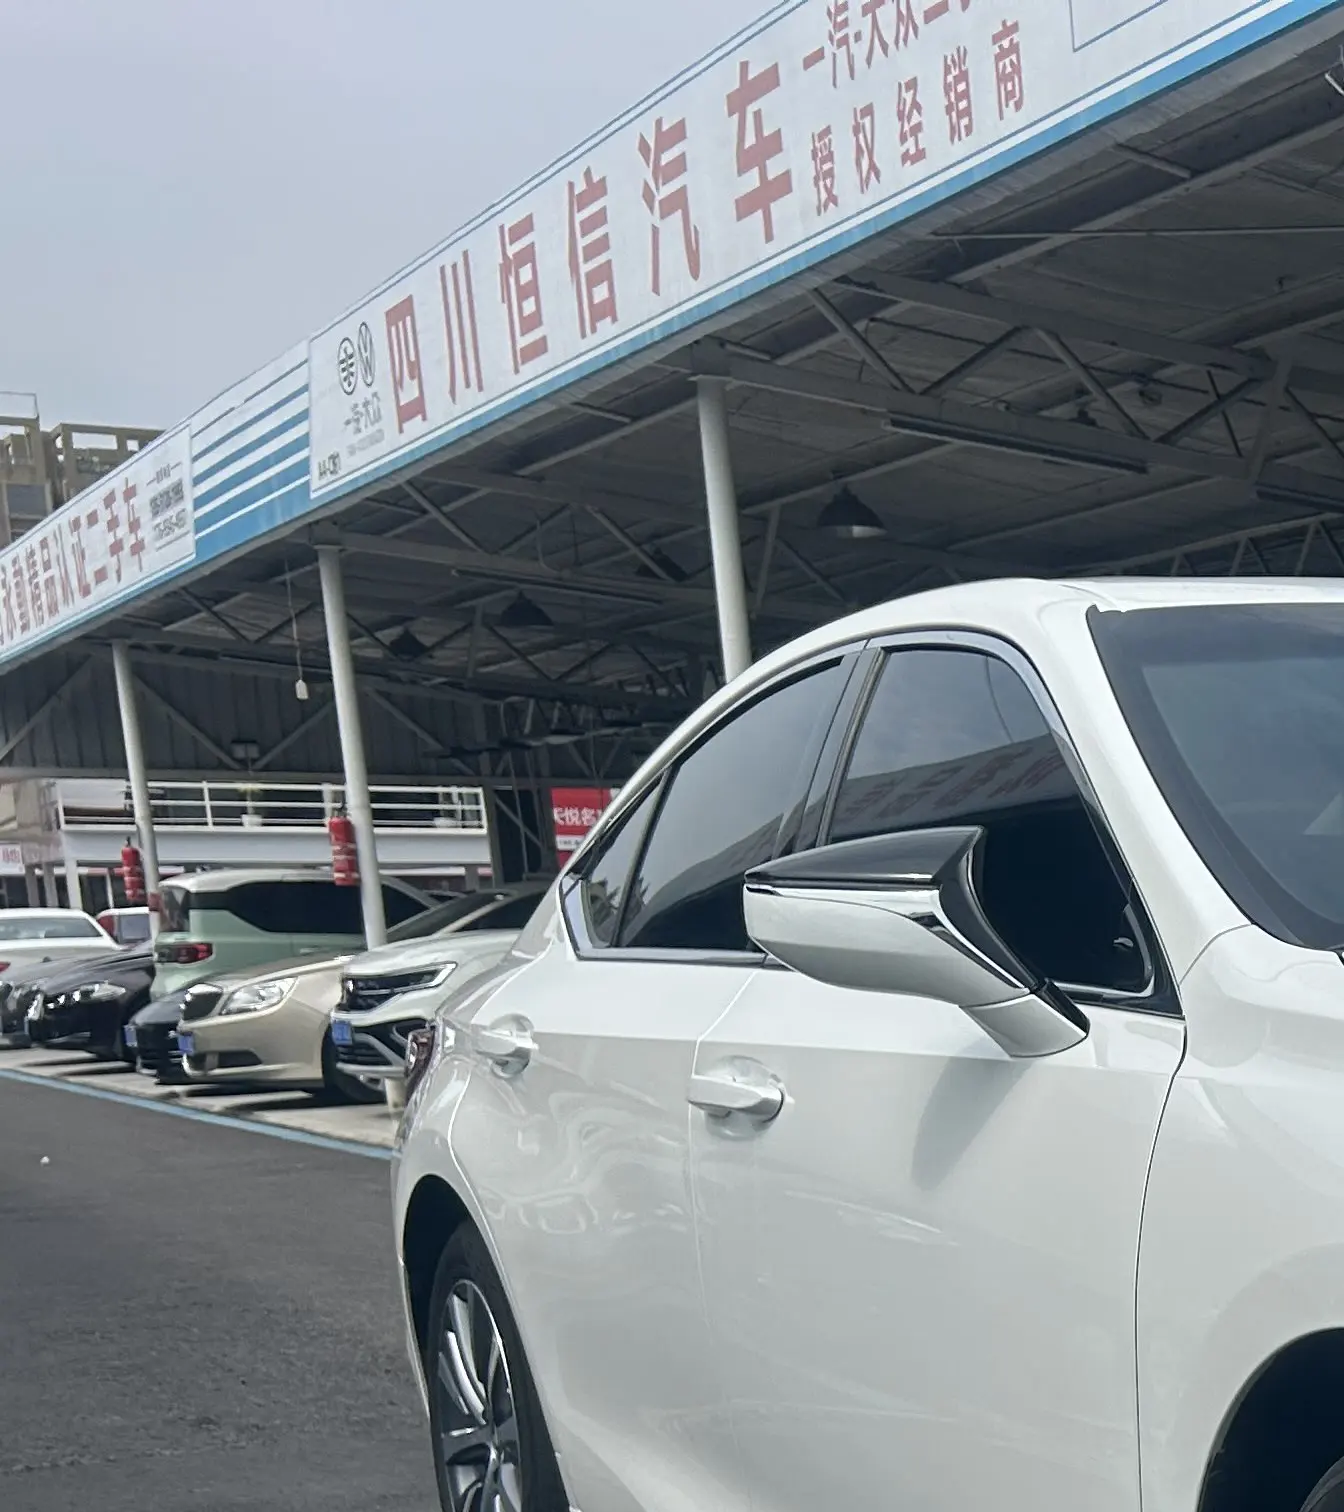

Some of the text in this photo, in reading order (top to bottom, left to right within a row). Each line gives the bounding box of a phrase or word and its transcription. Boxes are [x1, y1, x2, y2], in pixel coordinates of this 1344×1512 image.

[384, 60, 793, 435] 四川恒信汽车
[811, 18, 1024, 217] 授权经销商
